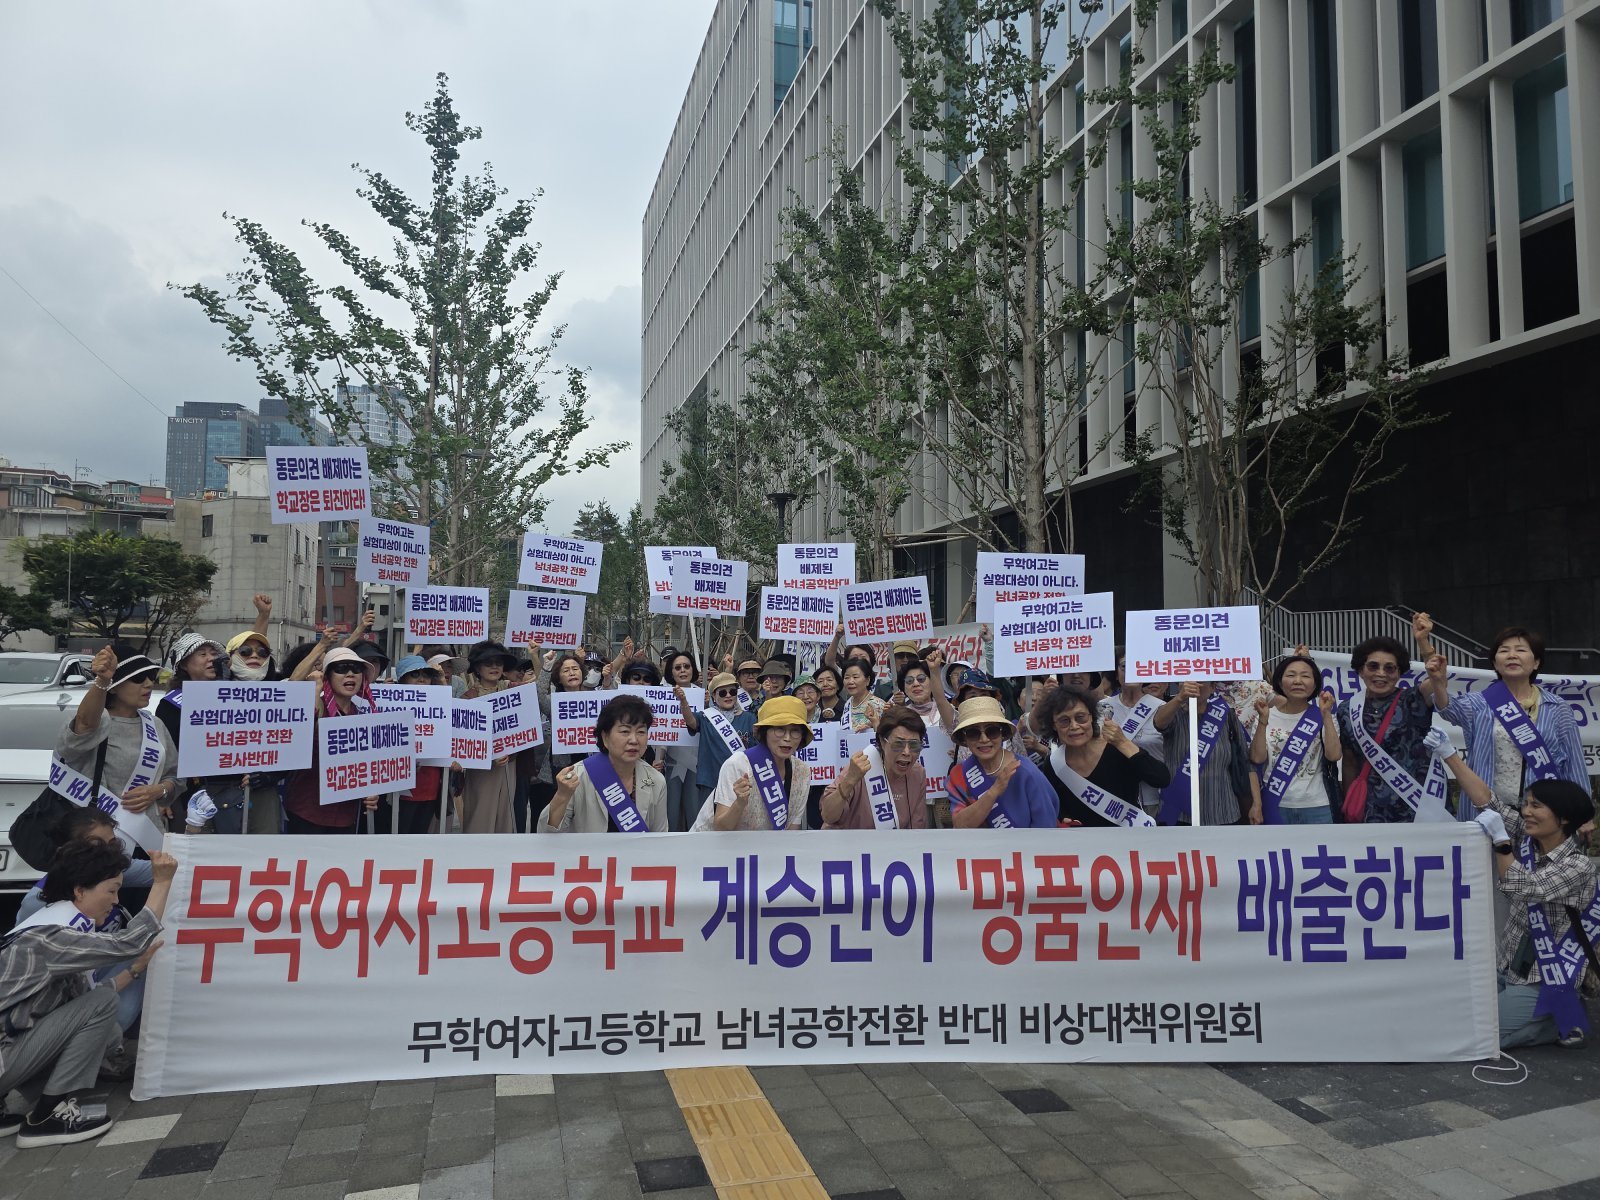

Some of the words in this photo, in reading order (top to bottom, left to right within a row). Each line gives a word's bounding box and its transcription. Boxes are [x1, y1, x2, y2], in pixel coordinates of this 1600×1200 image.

[276, 458, 320, 480] 동문의견
[322, 458, 361, 479] 배제하는
[277, 491, 320, 513] 학교장은
[322, 489, 366, 512] 퇴진하라!
[378, 523, 414, 539] 무학여고는
[363, 535, 401, 552] 실험대상이
[403, 541, 426, 555] 아니다.
[543, 538, 584, 553] 무학여고는
[794, 548, 838, 558] 동문의견
[371, 552, 402, 568] 남녀공학
[404, 556, 418, 568] 전환
[527, 548, 568, 563] 실험대상이
[571, 552, 597, 567] 아니다.
[1004, 558, 1059, 570] 무학여고는
[378, 568, 410, 582] 결사반대!
[535, 561, 568, 575] 남녀공학
[571, 565, 587, 577] 전환
[690, 561, 732, 577] 동문의견
[800, 563, 832, 574] 배제된
[541, 575, 578, 588] 결사반대!
[694, 580, 726, 594] 배제된
[983, 574, 1038, 587] 실험대상이
[1042, 575, 1078, 588] 아니다.
[412, 595, 448, 612] 동문의견
[449, 595, 483, 612] 배제하는
[526, 596, 570, 610] 동문의견
[677, 596, 741, 612] 남녀공학반대
[766, 594, 799, 612] 동문의견
[801, 596, 834, 614] 배제하는
[847, 591, 882, 611] 동문의견
[885, 586, 922, 608] 배제하는
[1021, 601, 1083, 618] 무학여고는
[409, 619, 445, 637] 학교장은
[448, 619, 484, 637] 퇴진하라!
[530, 614, 563, 628] 배제된
[764, 616, 797, 633] 학교장은
[799, 617, 834, 634] 퇴진하라!
[848, 617, 884, 635] 학교장은
[887, 612, 927, 633] 퇴진하라!
[1000, 619, 1061, 637] 실험대상이
[1064, 615, 1107, 633] 아니다.
[1154, 613, 1229, 630] 동문의견
[512, 630, 576, 645] 남녀공학반대
[1014, 638, 1064, 653] 남녀공학
[1067, 635, 1093, 649] 전환
[1163, 635, 1220, 652] 배제된
[1026, 655, 1080, 670] 결사반대!
[1135, 658, 1251, 677] 남녀공학반대
[218, 687, 286, 702] 무학여고는
[646, 690, 680, 700] 학여고
[190, 708, 261, 725] 실험대상이
[266, 708, 308, 723] 아니다.
[558, 700, 598, 720] 동문의견
[452, 708, 486, 731] 배제하는
[206, 730, 262, 747] 남녀공학
[266, 729, 293, 744] 전환
[327, 727, 368, 755] 동문의견
[372, 722, 409, 750] 배제하는
[492, 727, 538, 754] 공학반대
[648, 732, 678, 742] 사반대!
[451, 738, 487, 760] 퇴진하라!
[1268, 718, 1318, 796] 교장퇴진
[219, 750, 278, 768] 결사반대!
[326, 764, 368, 791] 학교장은
[371, 756, 411, 783] 퇴진하라!
[754, 758, 788, 830] 남녀공
[869, 776, 897, 829] 교장
[602, 782, 640, 832] 동문
[176, 857, 684, 984] 무학여자고등학교
[702, 855, 934, 968] 계승만이
[956, 849, 1218, 966] '명품인재'
[1237, 845, 1470, 963] 배출한다
[408, 1010, 704, 1064] 무학여자고등학교
[716, 1003, 928, 1051] 남녀공학전환
[938, 1003, 1008, 1045] 반대
[1020, 1002, 1263, 1045] 비상대책위원회
